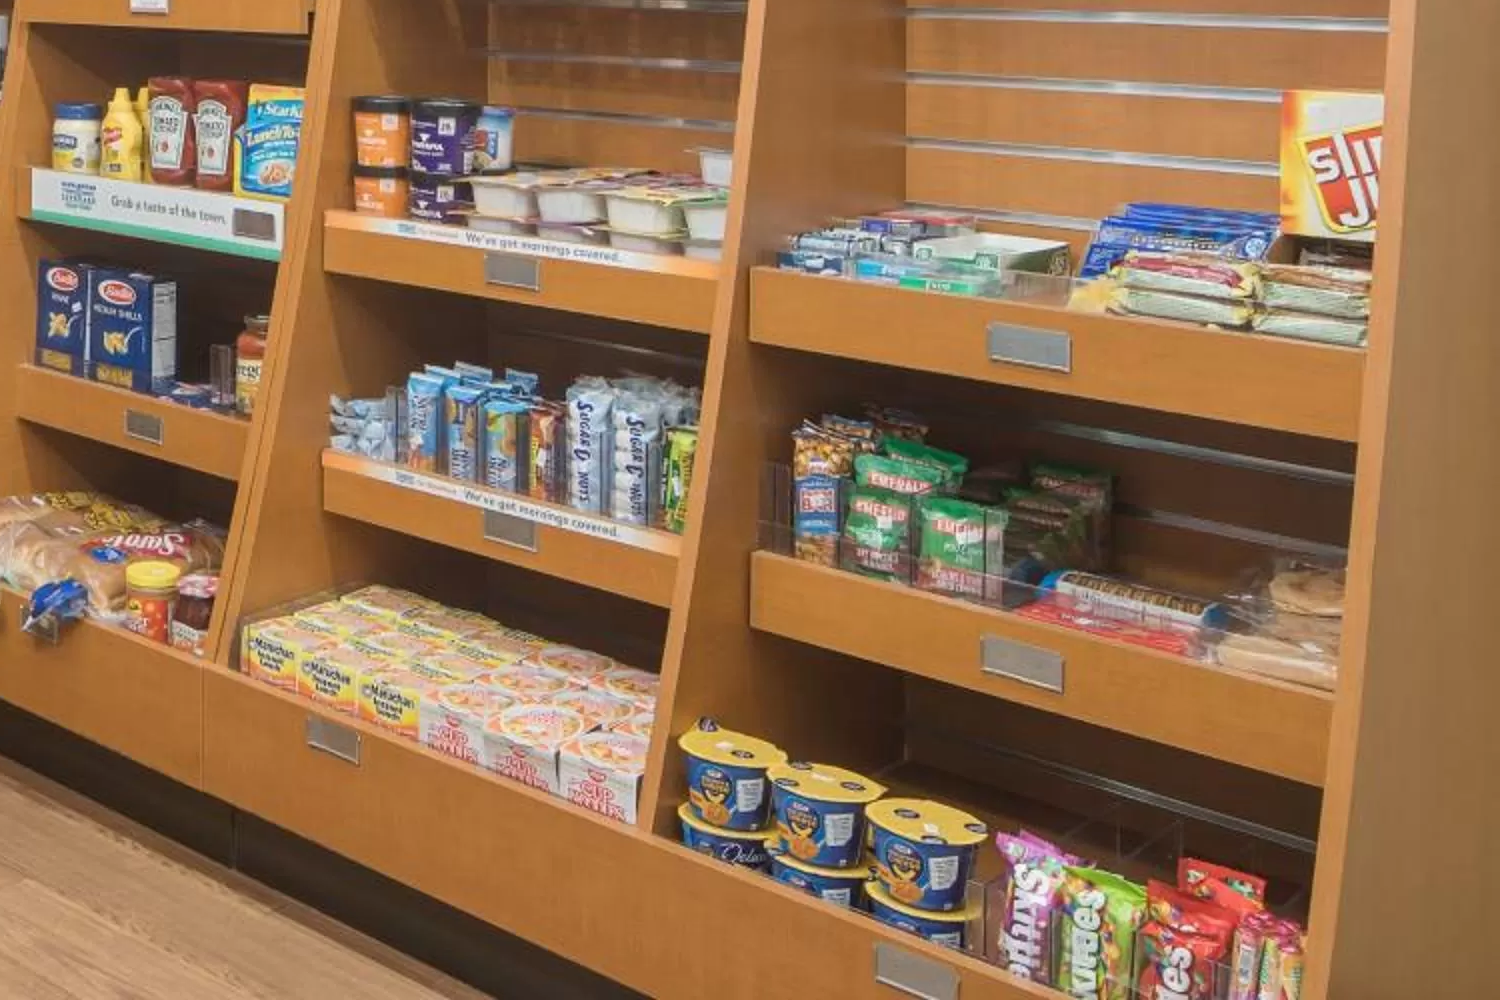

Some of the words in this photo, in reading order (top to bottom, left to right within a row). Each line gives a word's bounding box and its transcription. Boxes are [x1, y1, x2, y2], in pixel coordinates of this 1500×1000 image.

[263, 103, 302, 118] StarK
[111, 195, 134, 209] Grab
[180, 206, 197, 219] the
[465, 231, 497, 246] We've
[577, 401, 593, 447] SUGAR
[626, 415, 645, 462] SUGAR
[1007, 862, 1050, 980] Skittle
[1070, 889, 1106, 1000] kittles
